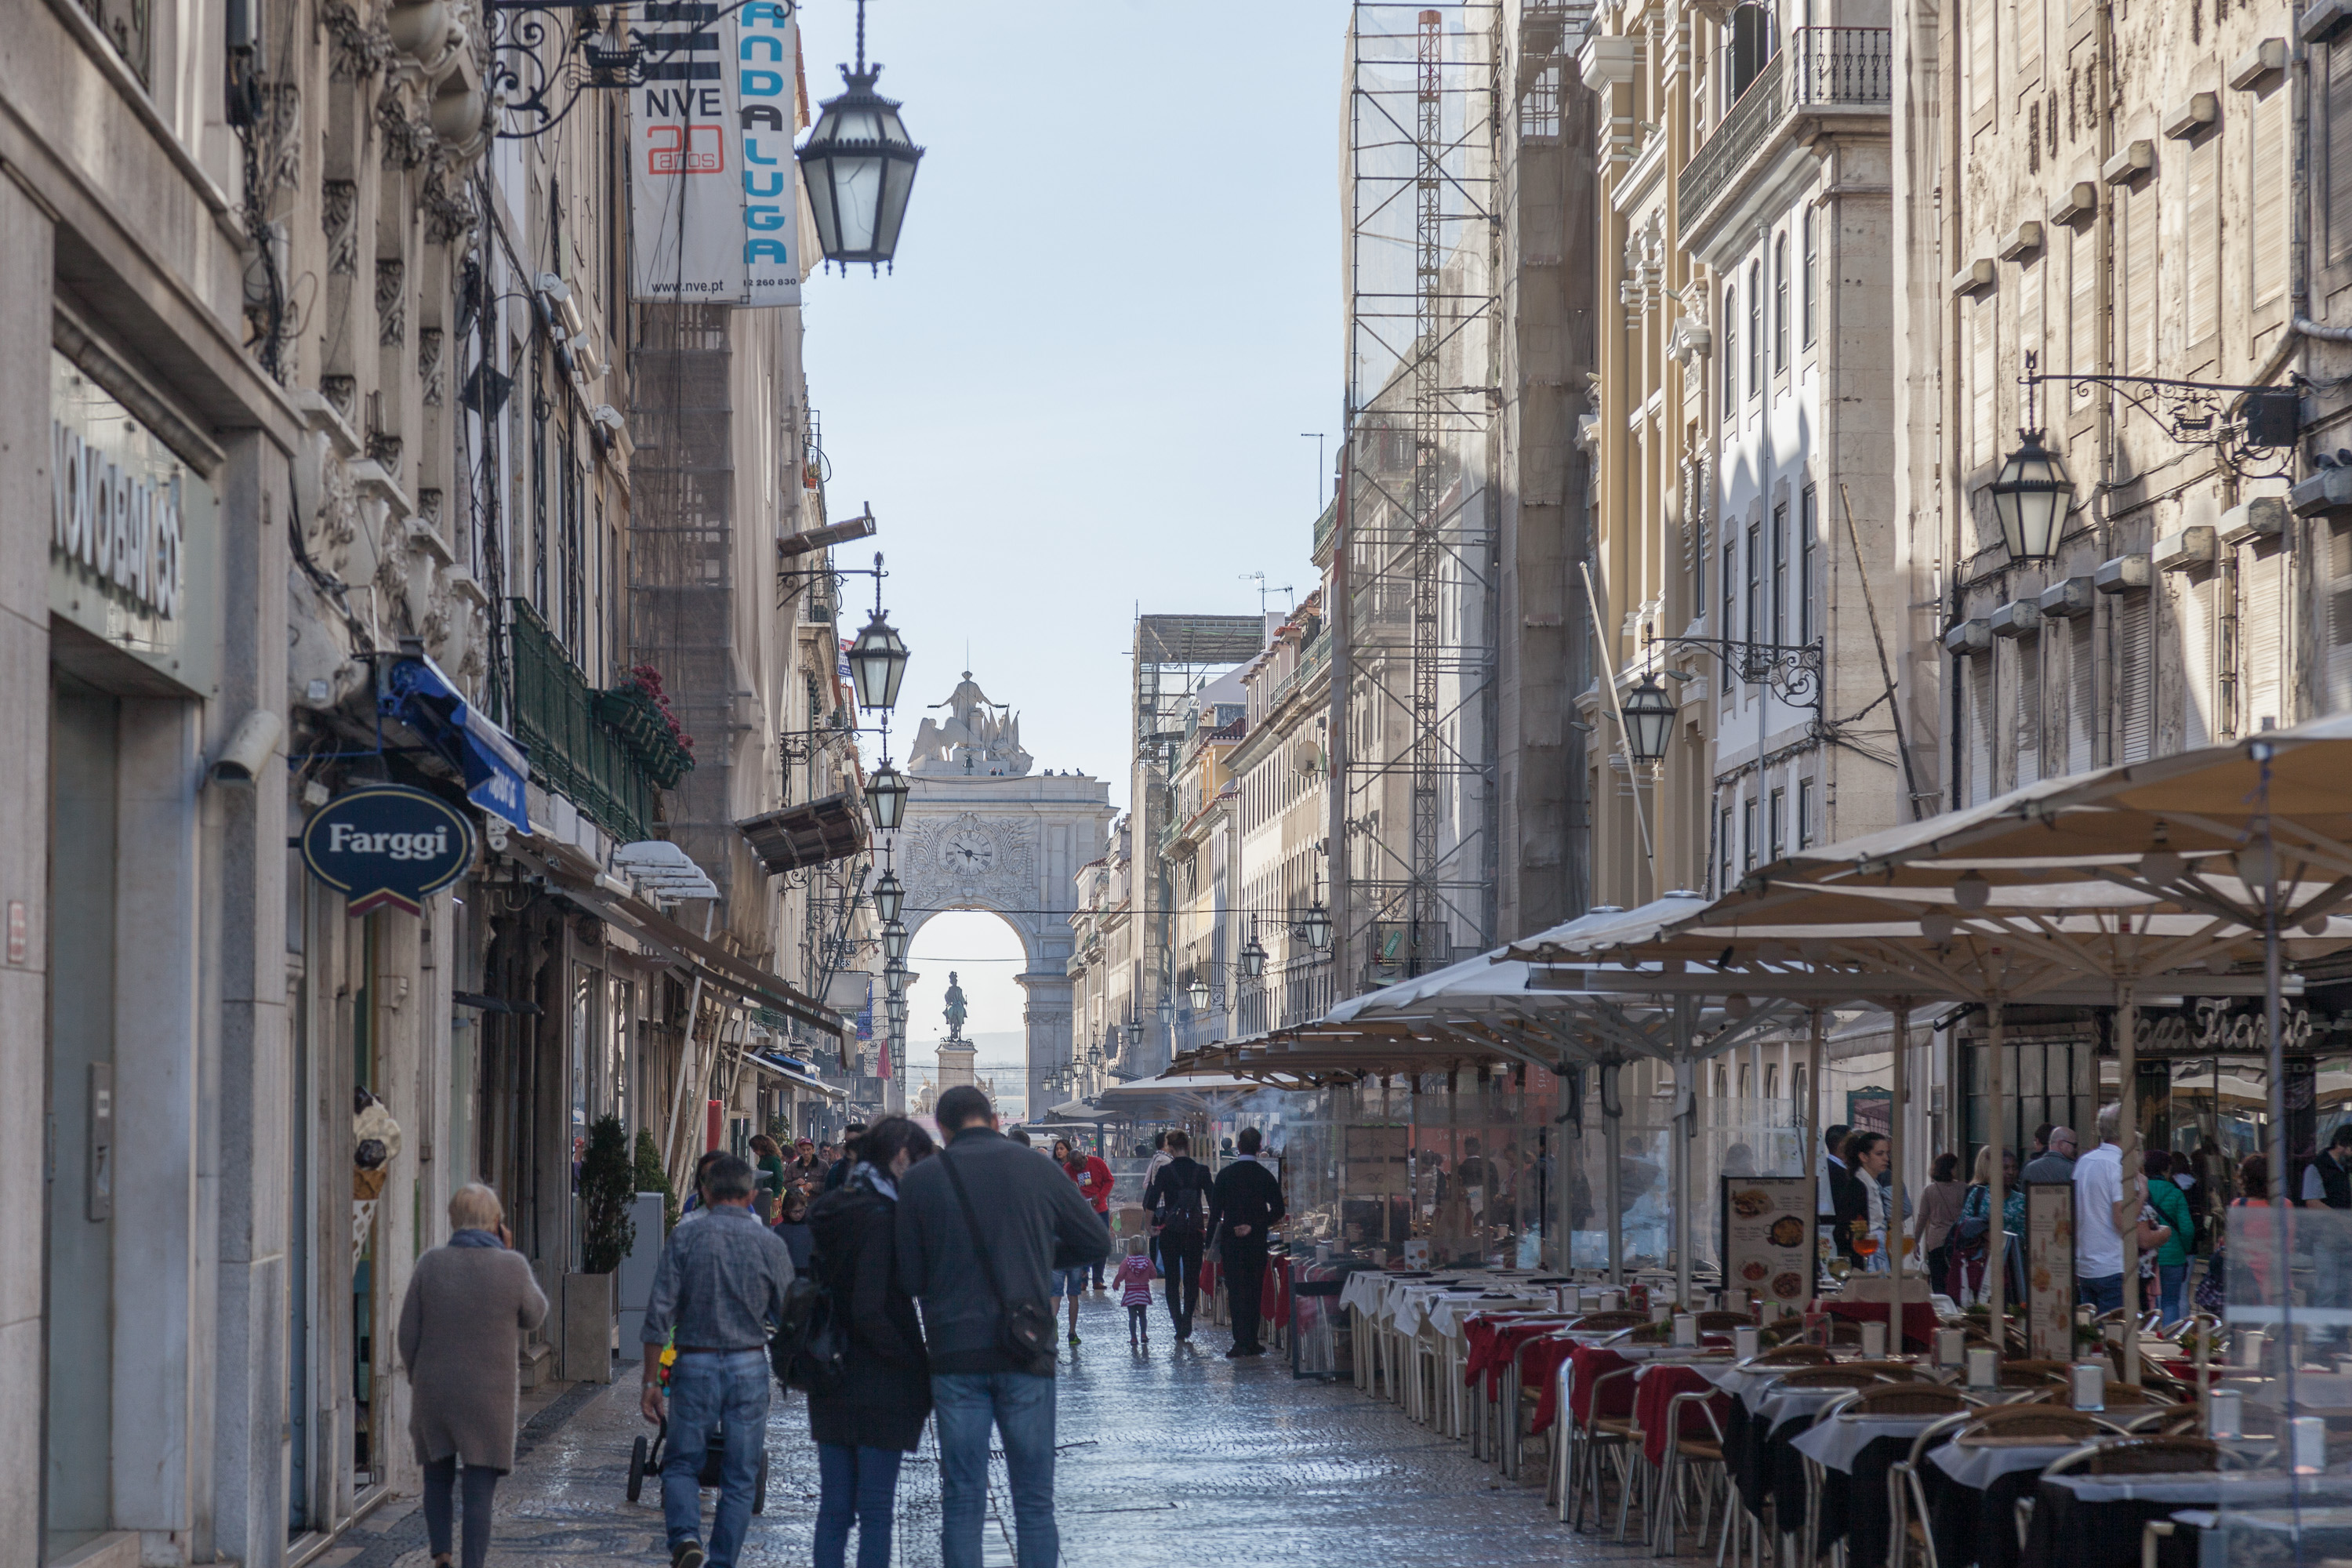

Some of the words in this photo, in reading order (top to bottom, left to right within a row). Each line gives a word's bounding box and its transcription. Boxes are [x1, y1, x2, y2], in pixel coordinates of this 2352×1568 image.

[646, 88, 722, 117] NVE
[740, 2, 787, 265] ANDALUGA
[660, 154, 715, 169] anos
[652, 279, 724, 293] www.nve.pt
[756, 278, 775, 287] 260
[778, 278, 797, 286] 830
[328, 823, 448, 861] Farggi
